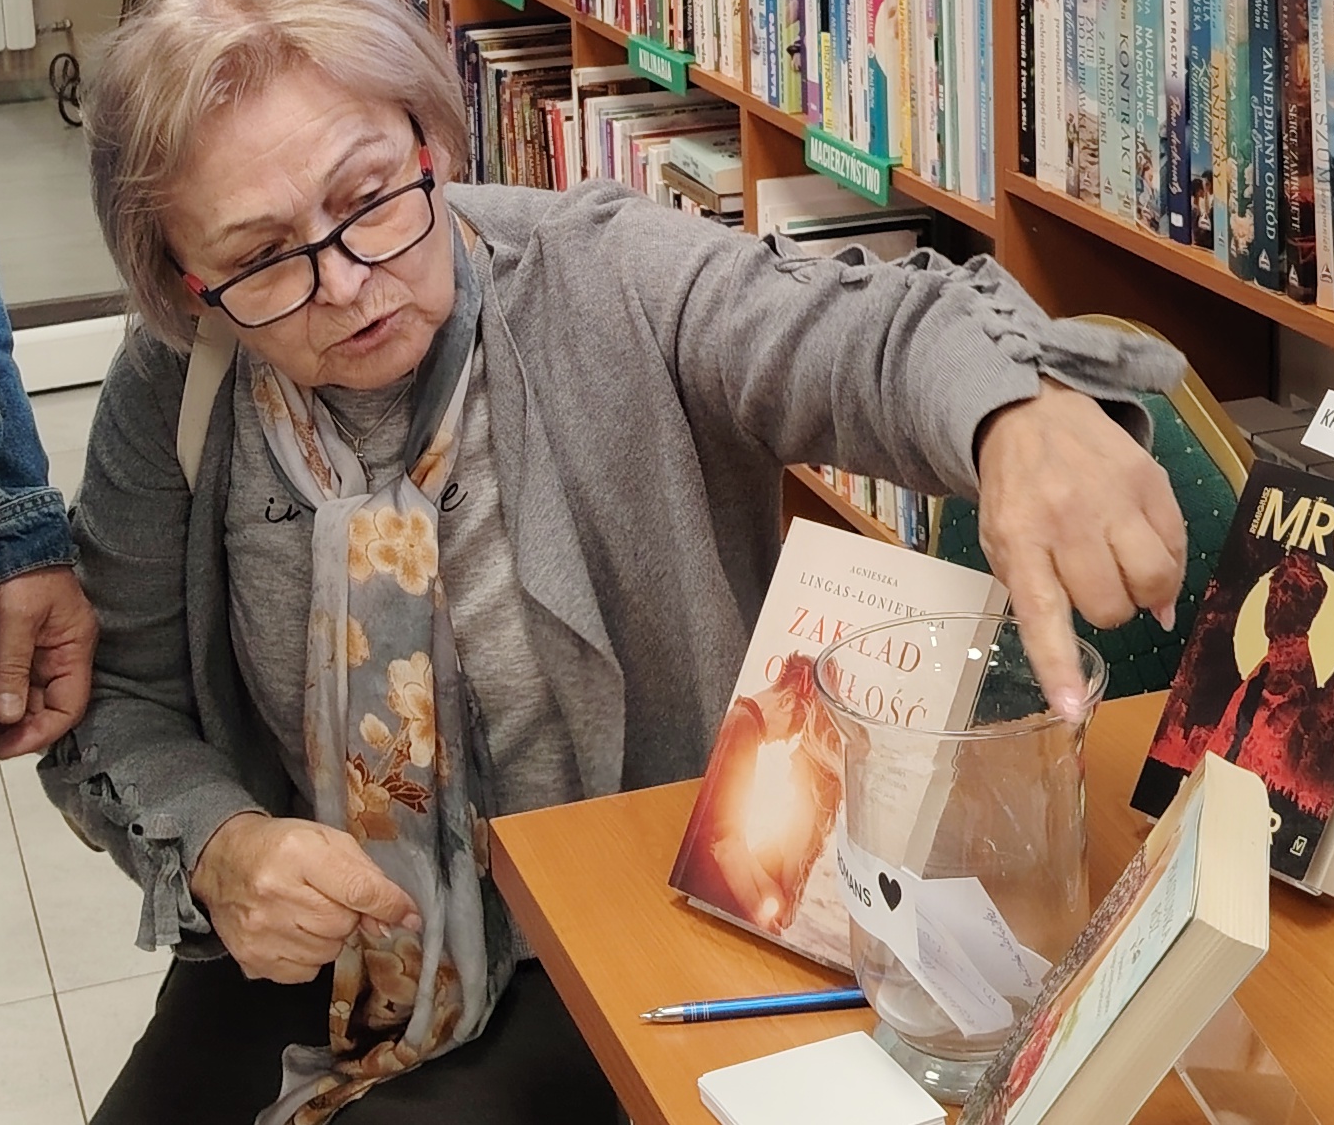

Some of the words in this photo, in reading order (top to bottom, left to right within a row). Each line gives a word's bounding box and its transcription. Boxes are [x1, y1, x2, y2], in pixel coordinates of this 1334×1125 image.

[1135, 25, 1143, 46] NA
[1145, 27, 1154, 78] NAUCZ
[639, 48, 672, 82] KULINARIA
[1135, 49, 1144, 98] NOWO
[1119, 33, 1132, 182] KONTRAKT
[1145, 81, 1154, 117] MNIE
[1170, 96, 1182, 127] Plan
[1262, 47, 1276, 167] ZANIEDBANY
[811, 136, 880, 195] MACIERZYŃSTWO
[1265, 171, 1278, 240] OGRÓD
[800, 572, 945, 630] LINGAS-ŁONIEWSA
[849, 565, 898, 588] AGNIESZKA
